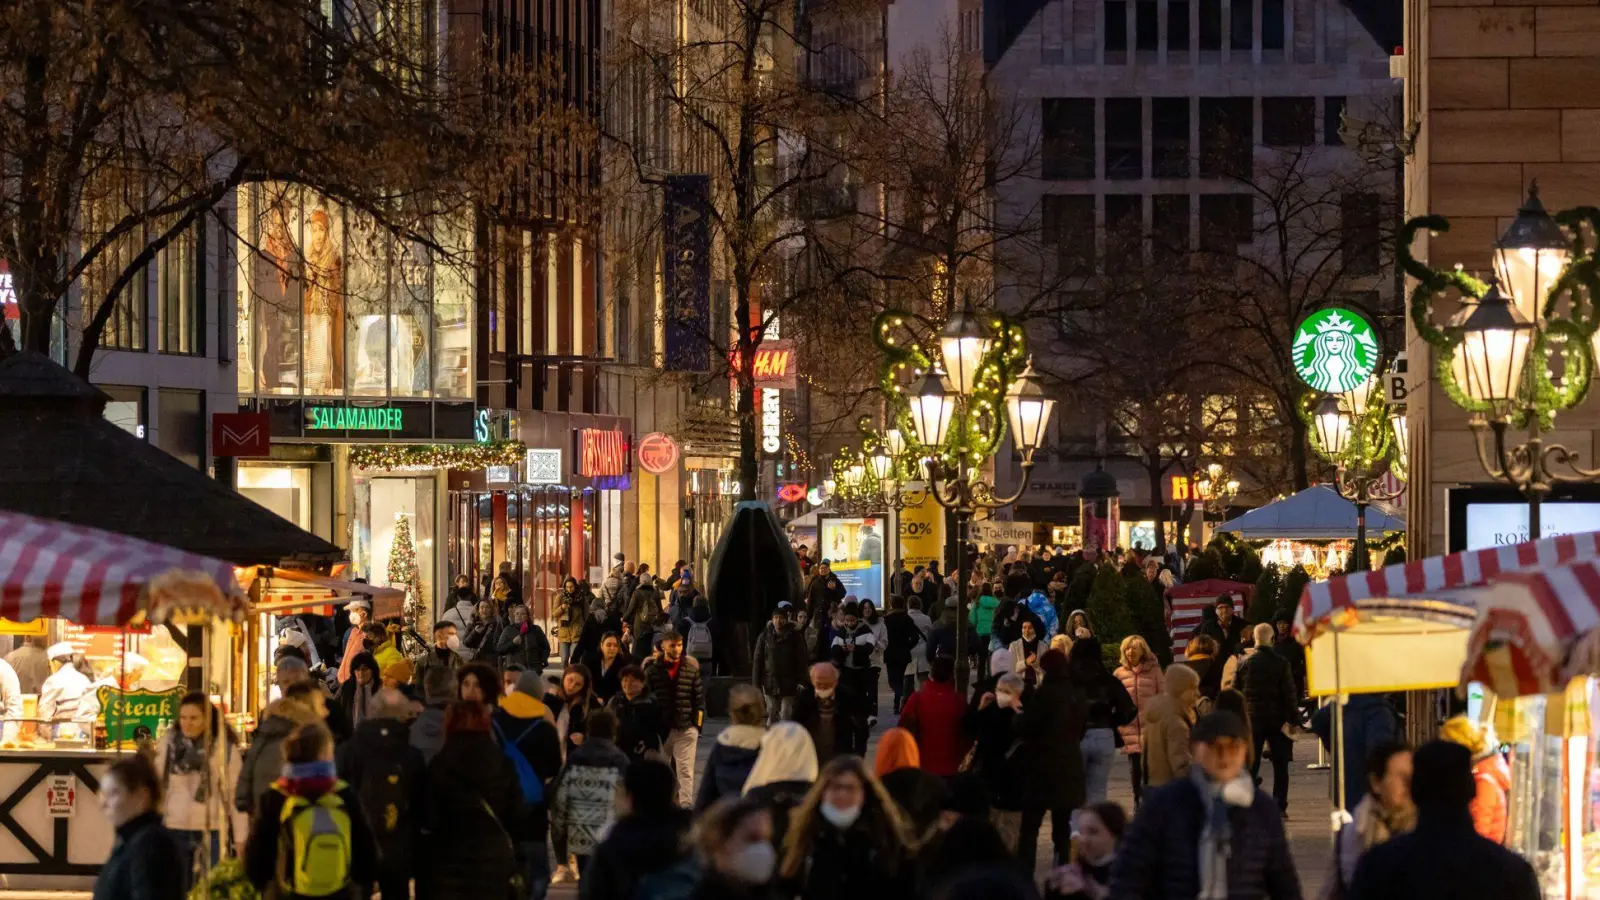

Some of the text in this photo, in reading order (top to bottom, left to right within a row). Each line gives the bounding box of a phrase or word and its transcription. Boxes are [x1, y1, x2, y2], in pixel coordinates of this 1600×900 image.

[753, 351, 789, 376] H&M
[313, 407, 403, 430] SALAMANDER
[583, 428, 623, 476] ROSSMANN
[984, 527, 1032, 539] Toiletten
[113, 699, 172, 717] Steak
